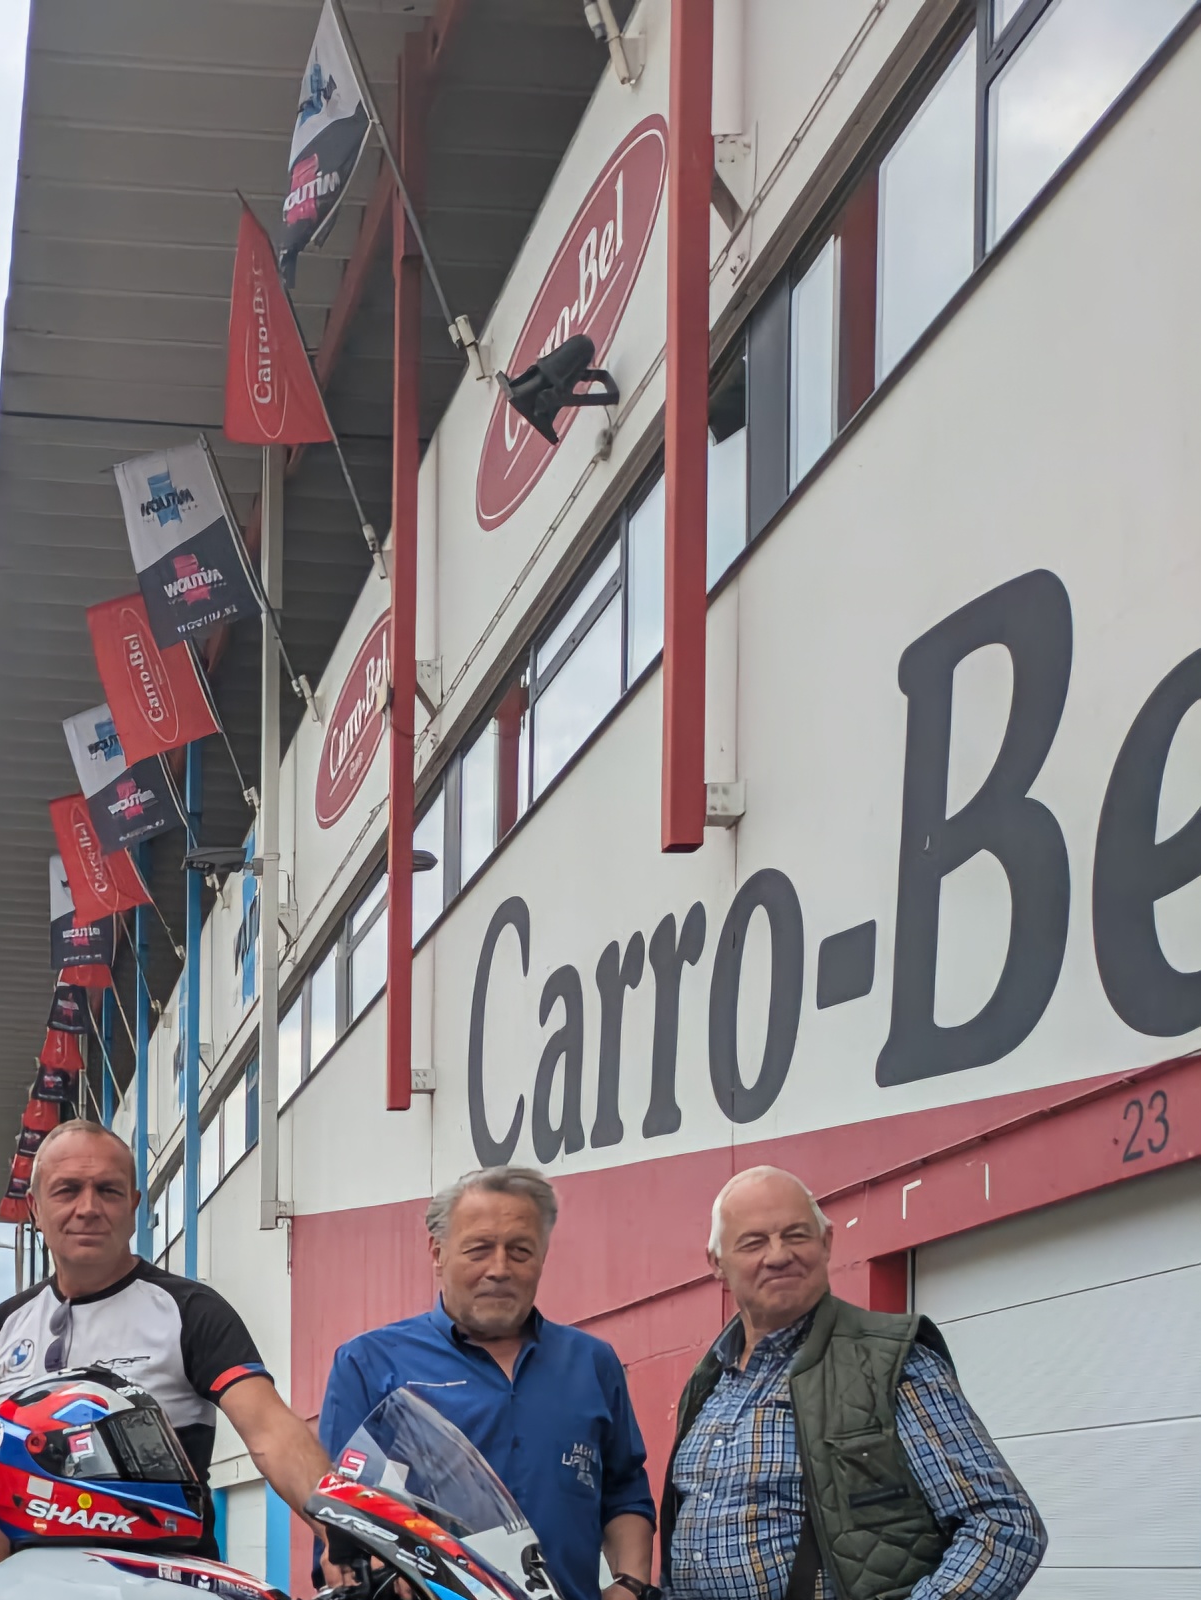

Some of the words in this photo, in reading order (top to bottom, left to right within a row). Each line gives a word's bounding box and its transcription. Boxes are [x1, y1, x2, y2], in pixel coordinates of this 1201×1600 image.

[1122, 1090, 1171, 1163] 23
[25, 1499, 140, 1535] SHARK
[315, 1507, 399, 1542] MRP
